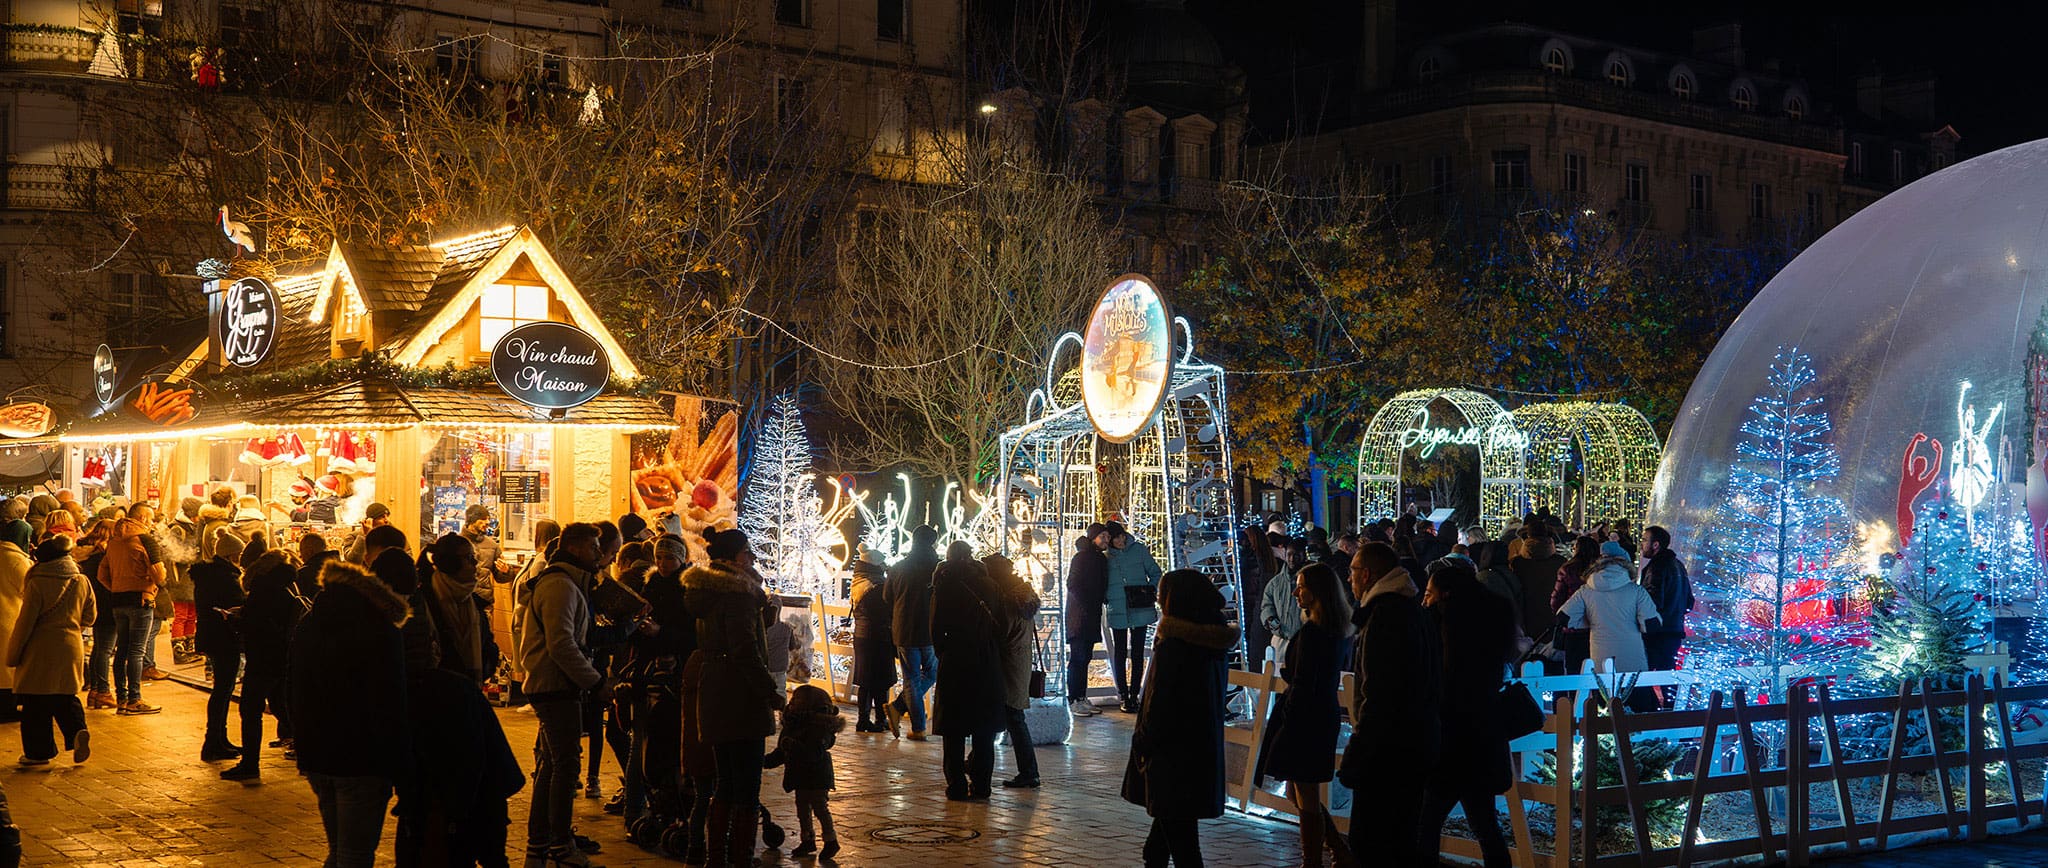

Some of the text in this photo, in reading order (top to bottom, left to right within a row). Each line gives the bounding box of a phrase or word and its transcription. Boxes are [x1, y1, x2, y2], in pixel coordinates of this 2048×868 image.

[506, 337, 598, 366] Vin chaud
[514, 366, 588, 393] Maison
[1400, 407, 1480, 458] Joyeuses
